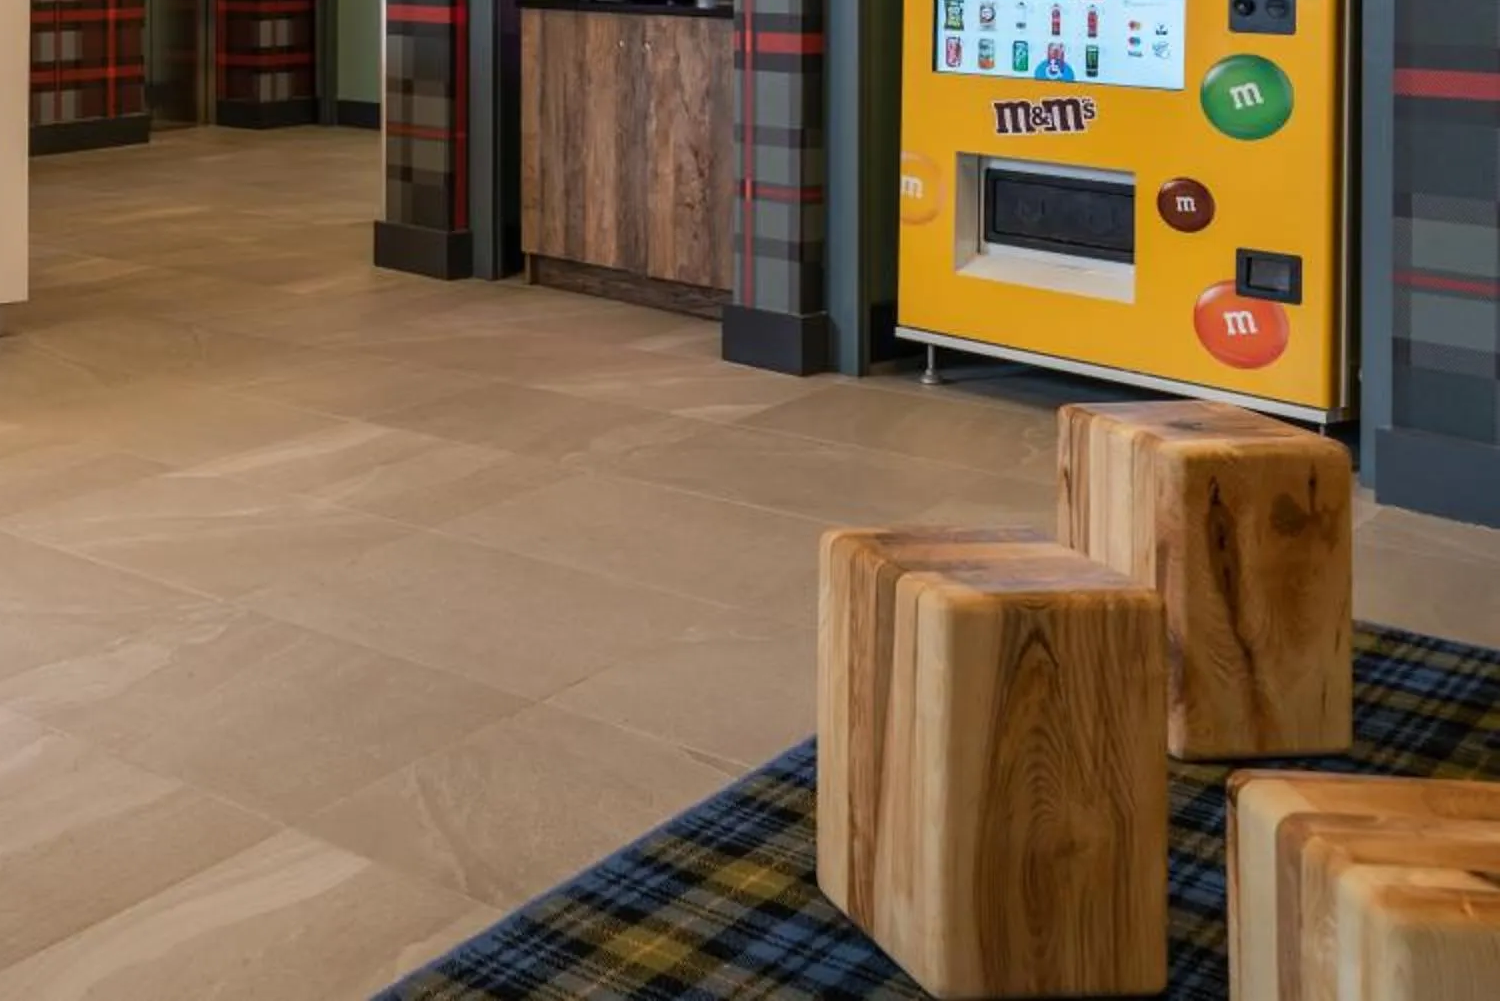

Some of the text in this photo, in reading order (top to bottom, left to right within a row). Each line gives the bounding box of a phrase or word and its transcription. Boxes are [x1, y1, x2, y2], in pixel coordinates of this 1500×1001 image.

[1230, 82, 1263, 109] m
[1176, 195, 1196, 211] m
[1224, 310, 1257, 336] m
